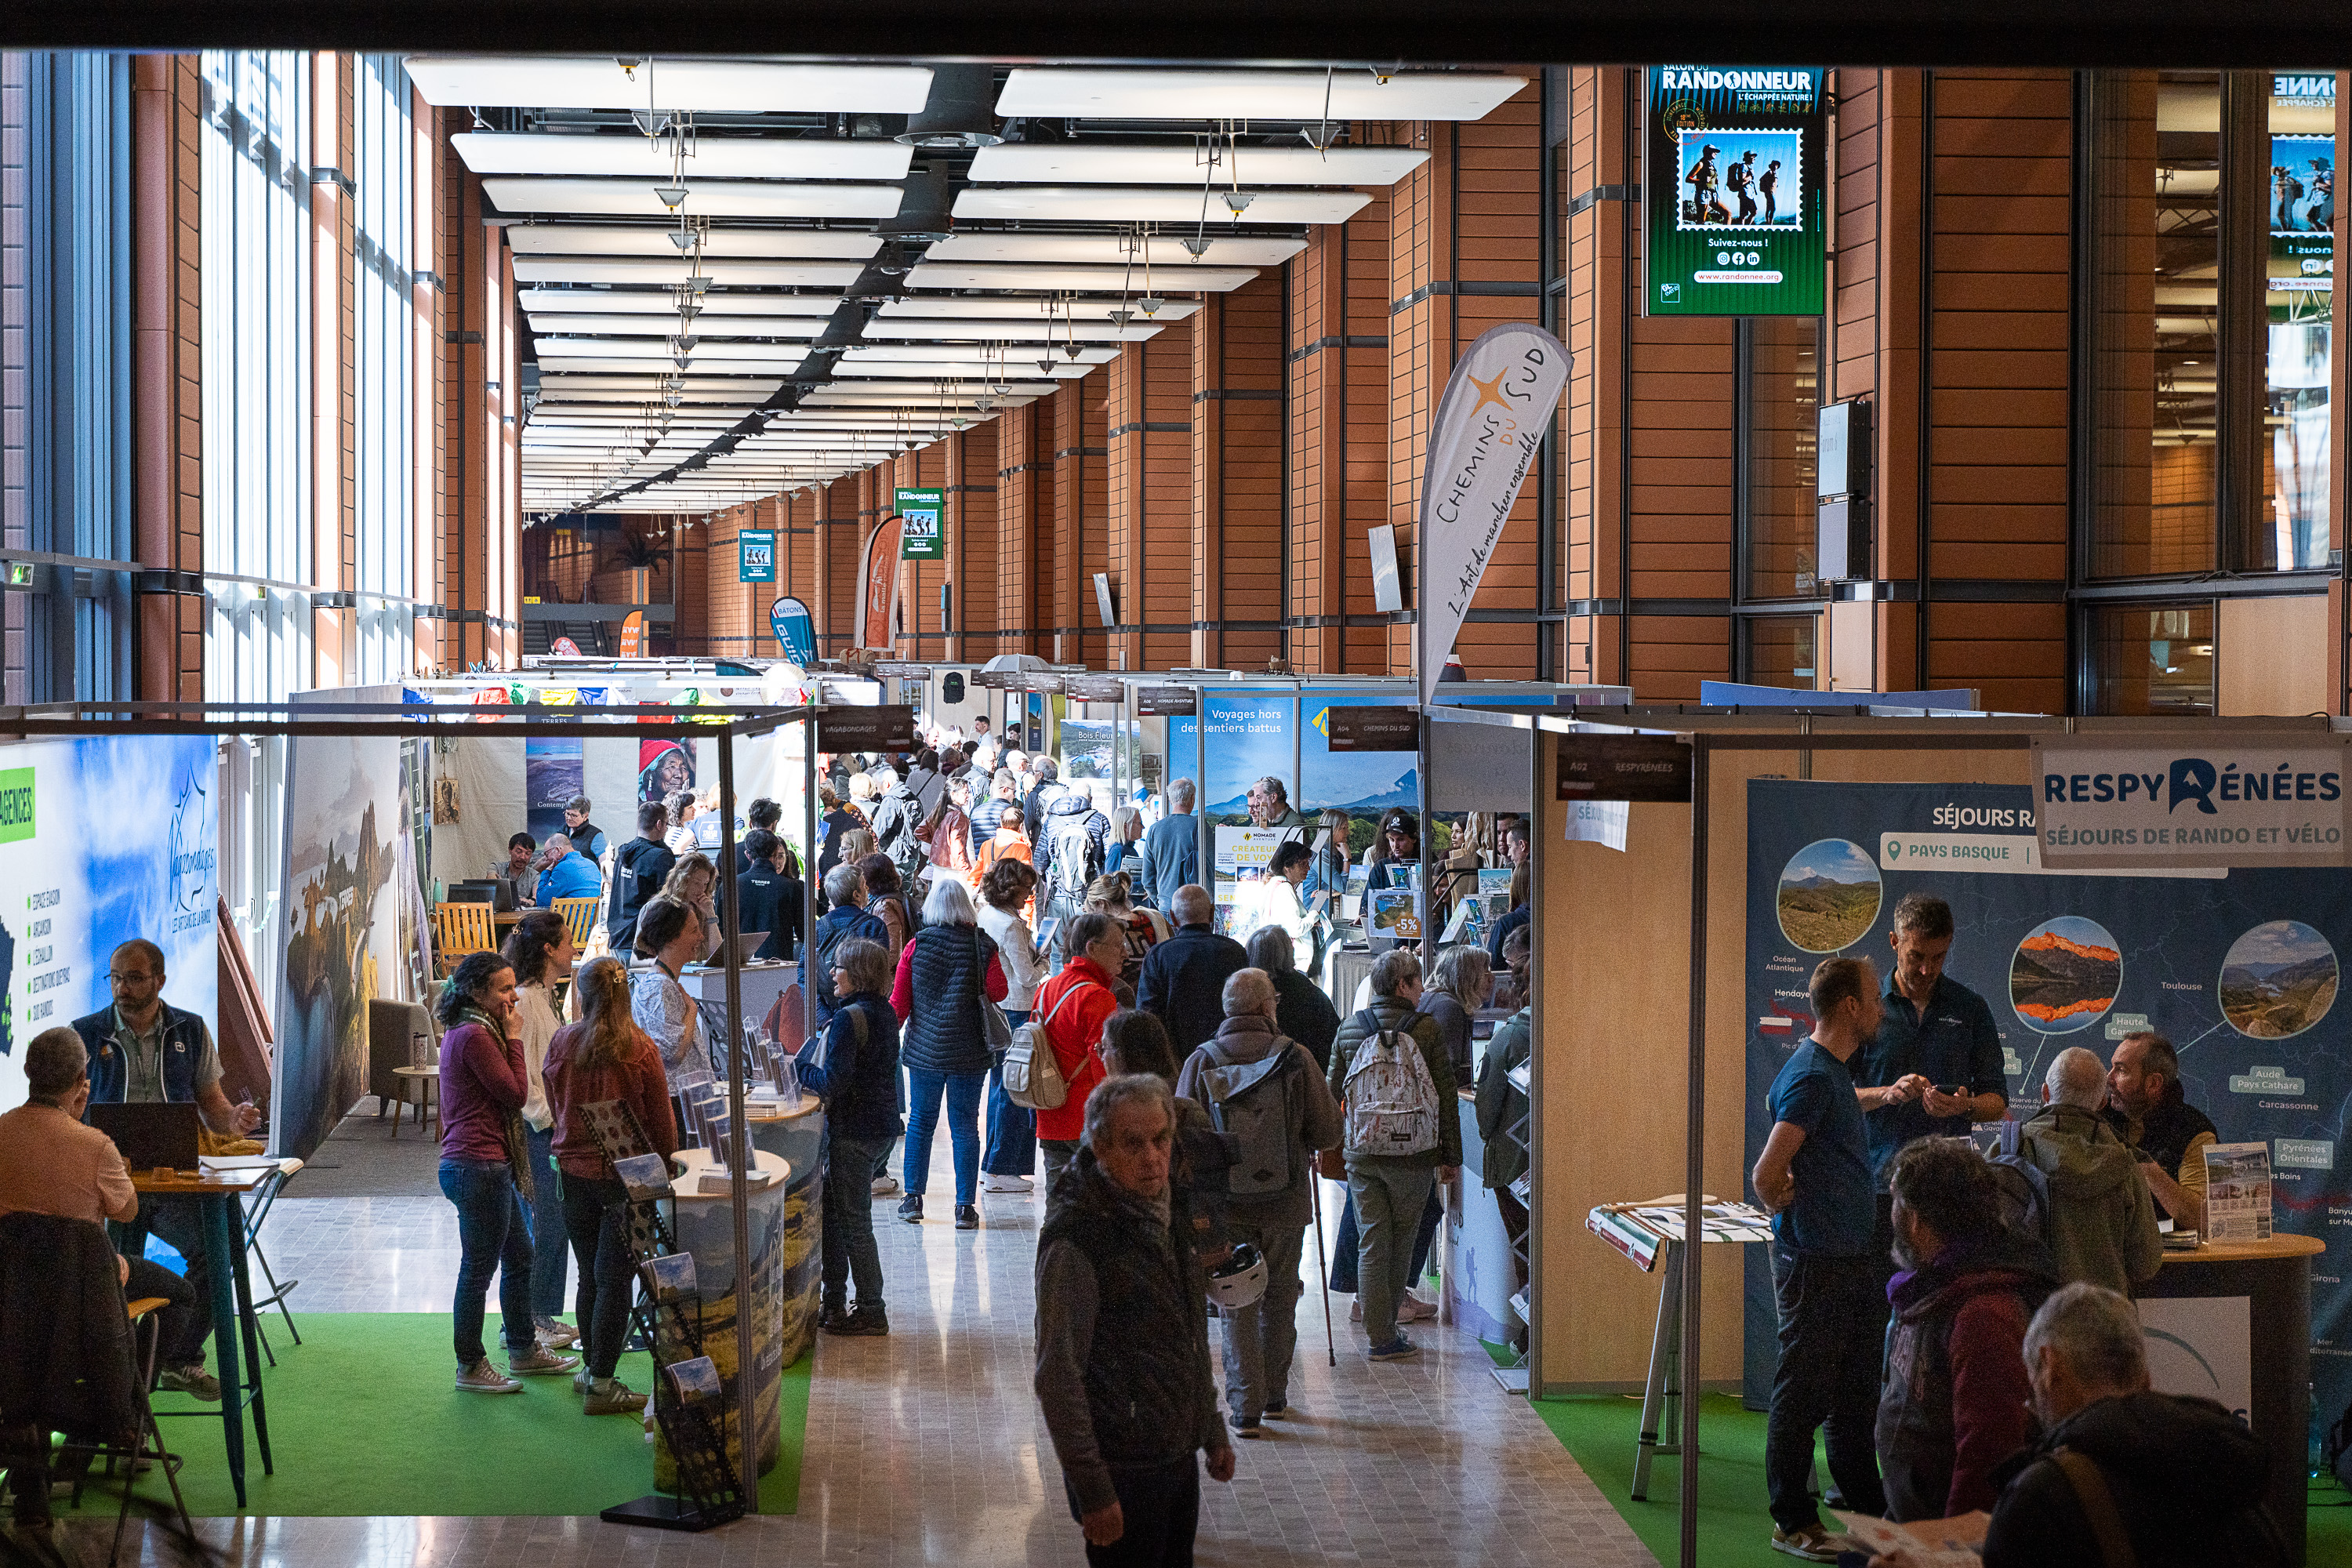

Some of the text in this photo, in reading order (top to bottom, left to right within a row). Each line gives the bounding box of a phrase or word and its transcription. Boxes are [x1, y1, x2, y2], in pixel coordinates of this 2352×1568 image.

[1662, 71, 1812, 90] RANDONNEUR
[1738, 93, 1780, 101] L'ÉCHAPPÉE
[1708, 238, 1763, 247] Suivez-nous
[1698, 273, 1780, 282] www.randonnee.org
[1661, 284, 1673, 292] GL
[1504, 347, 1544, 402] SUD
[1436, 414, 1517, 524] CHEMINS DU
[1447, 563, 1480, 619] L'Art
[1470, 546, 1486, 566] de
[1510, 430, 1538, 488] ensemble
[1212, 709, 1281, 721] Voyages hors
[1181, 723, 1281, 733] des sentiers battus
[1614, 761, 1674, 773] RESPYRÉNÉES
[2044, 757, 2342, 815] RESPYRÉNÉES
[1933, 804, 2015, 829] SÉJOURS
[2046, 822, 2341, 847] SÉJOURS DE RANDO ET VÉLO
[1909, 844, 2010, 860] PAYS BASQUE
[1396, 919, 1417, 931] -5%
[1766, 964, 1804, 973] Atlantique
[2161, 982, 2202, 991] Toulouse
[1775, 989, 1809, 999] Hendaye
[2116, 1018, 2144, 1026] Haute
[2256, 1070, 2281, 1079] Aude
[2238, 1080, 2299, 1091] Pays Cathare
[2258, 1101, 2319, 1111] Carcassonne
[2283, 1144, 2327, 1154] Pyrénées
[2280, 1154, 2328, 1164] Orientales
[2280, 1172, 2301, 1181] Bains
